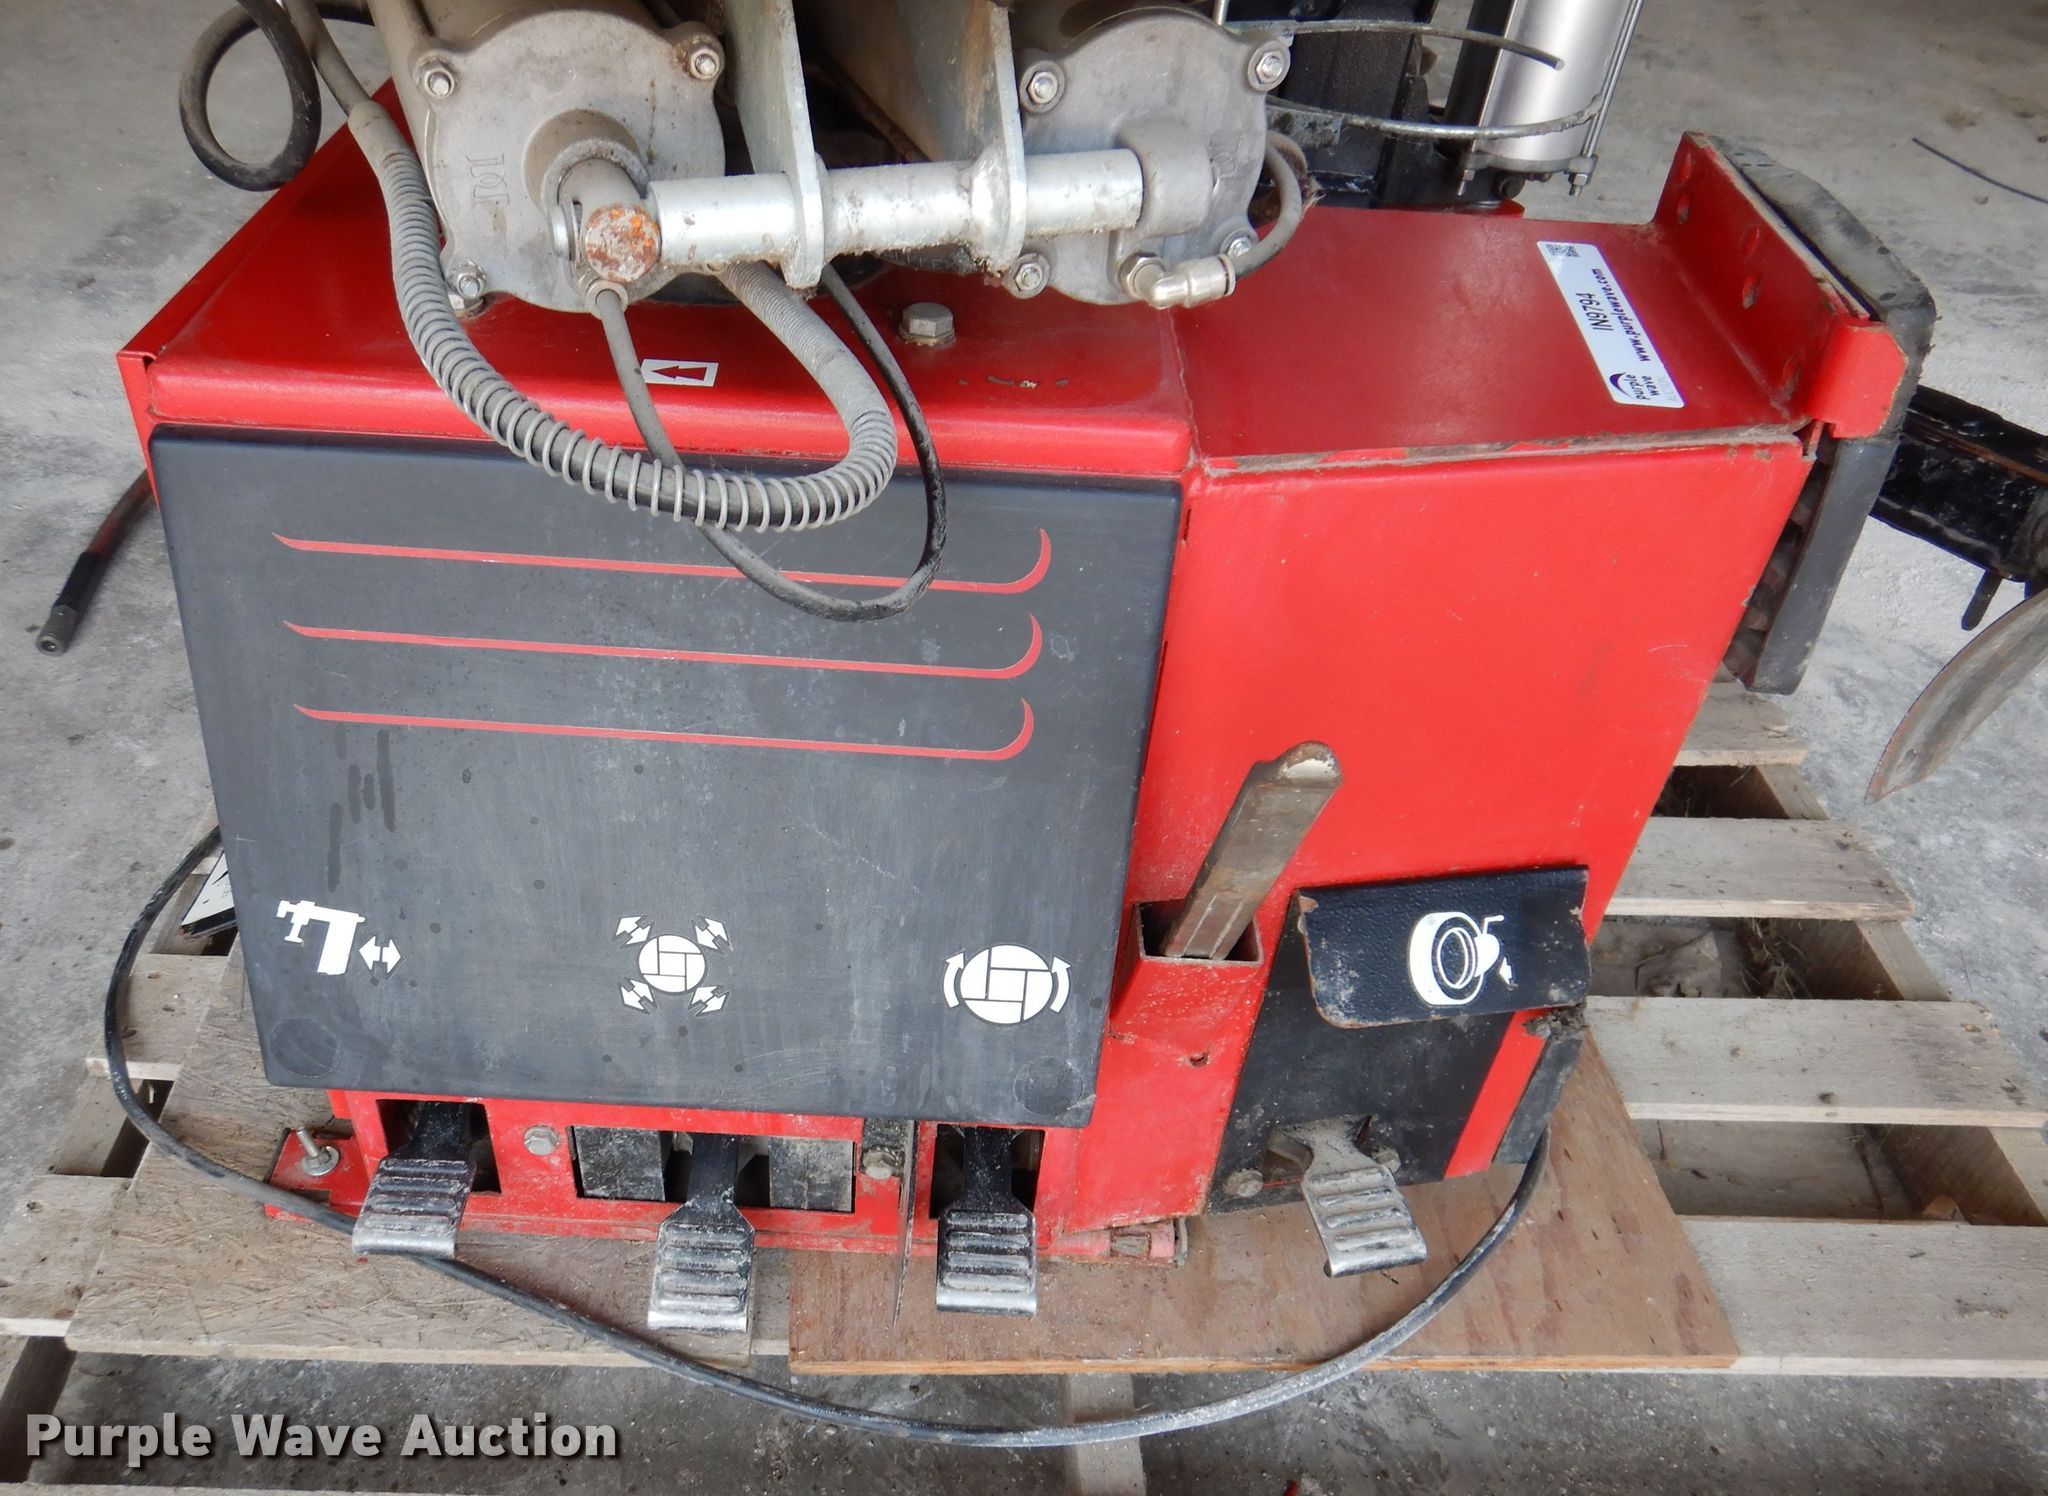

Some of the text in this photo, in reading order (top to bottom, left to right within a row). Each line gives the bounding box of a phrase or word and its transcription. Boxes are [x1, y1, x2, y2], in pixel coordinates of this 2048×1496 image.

[1576, 293, 1613, 331] IN9794
[1592, 268, 1651, 362] www.purplewave.com
[1626, 374, 1651, 400] purple
[1642, 375, 1659, 396] wave
